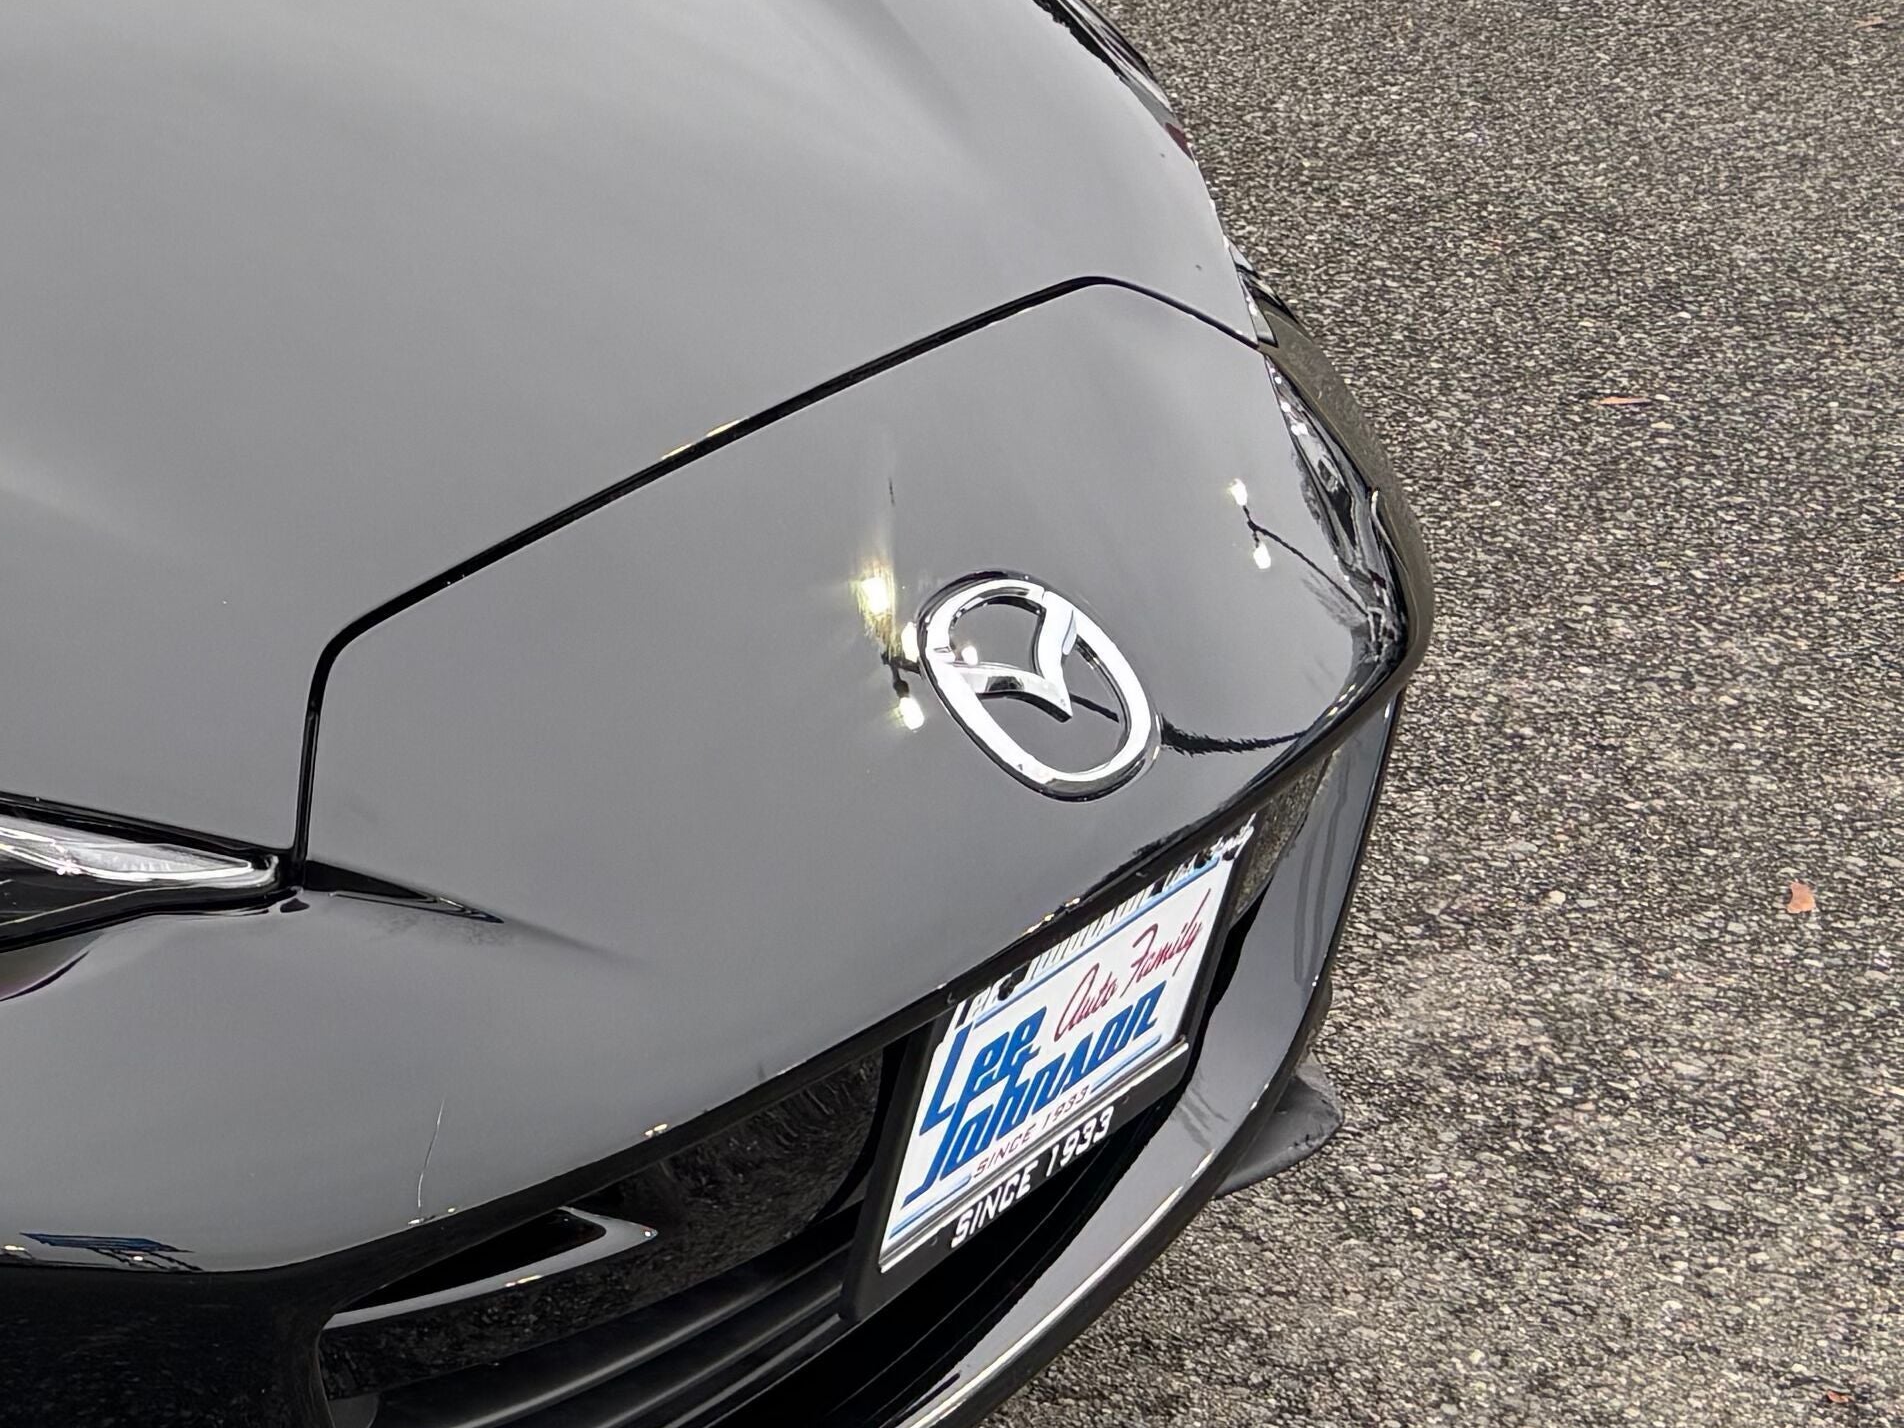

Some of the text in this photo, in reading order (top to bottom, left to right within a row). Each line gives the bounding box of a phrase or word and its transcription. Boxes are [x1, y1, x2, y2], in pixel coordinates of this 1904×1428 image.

[901, 980, 1167, 1209] Johnson
[918, 1006, 1047, 1136] Lee
[1054, 963, 1120, 1043] Auto
[1119, 887, 1212, 998] Family
[950, 1105, 1115, 1248] SINCE 1933
[972, 1085, 1092, 1179] SINCE 1933
